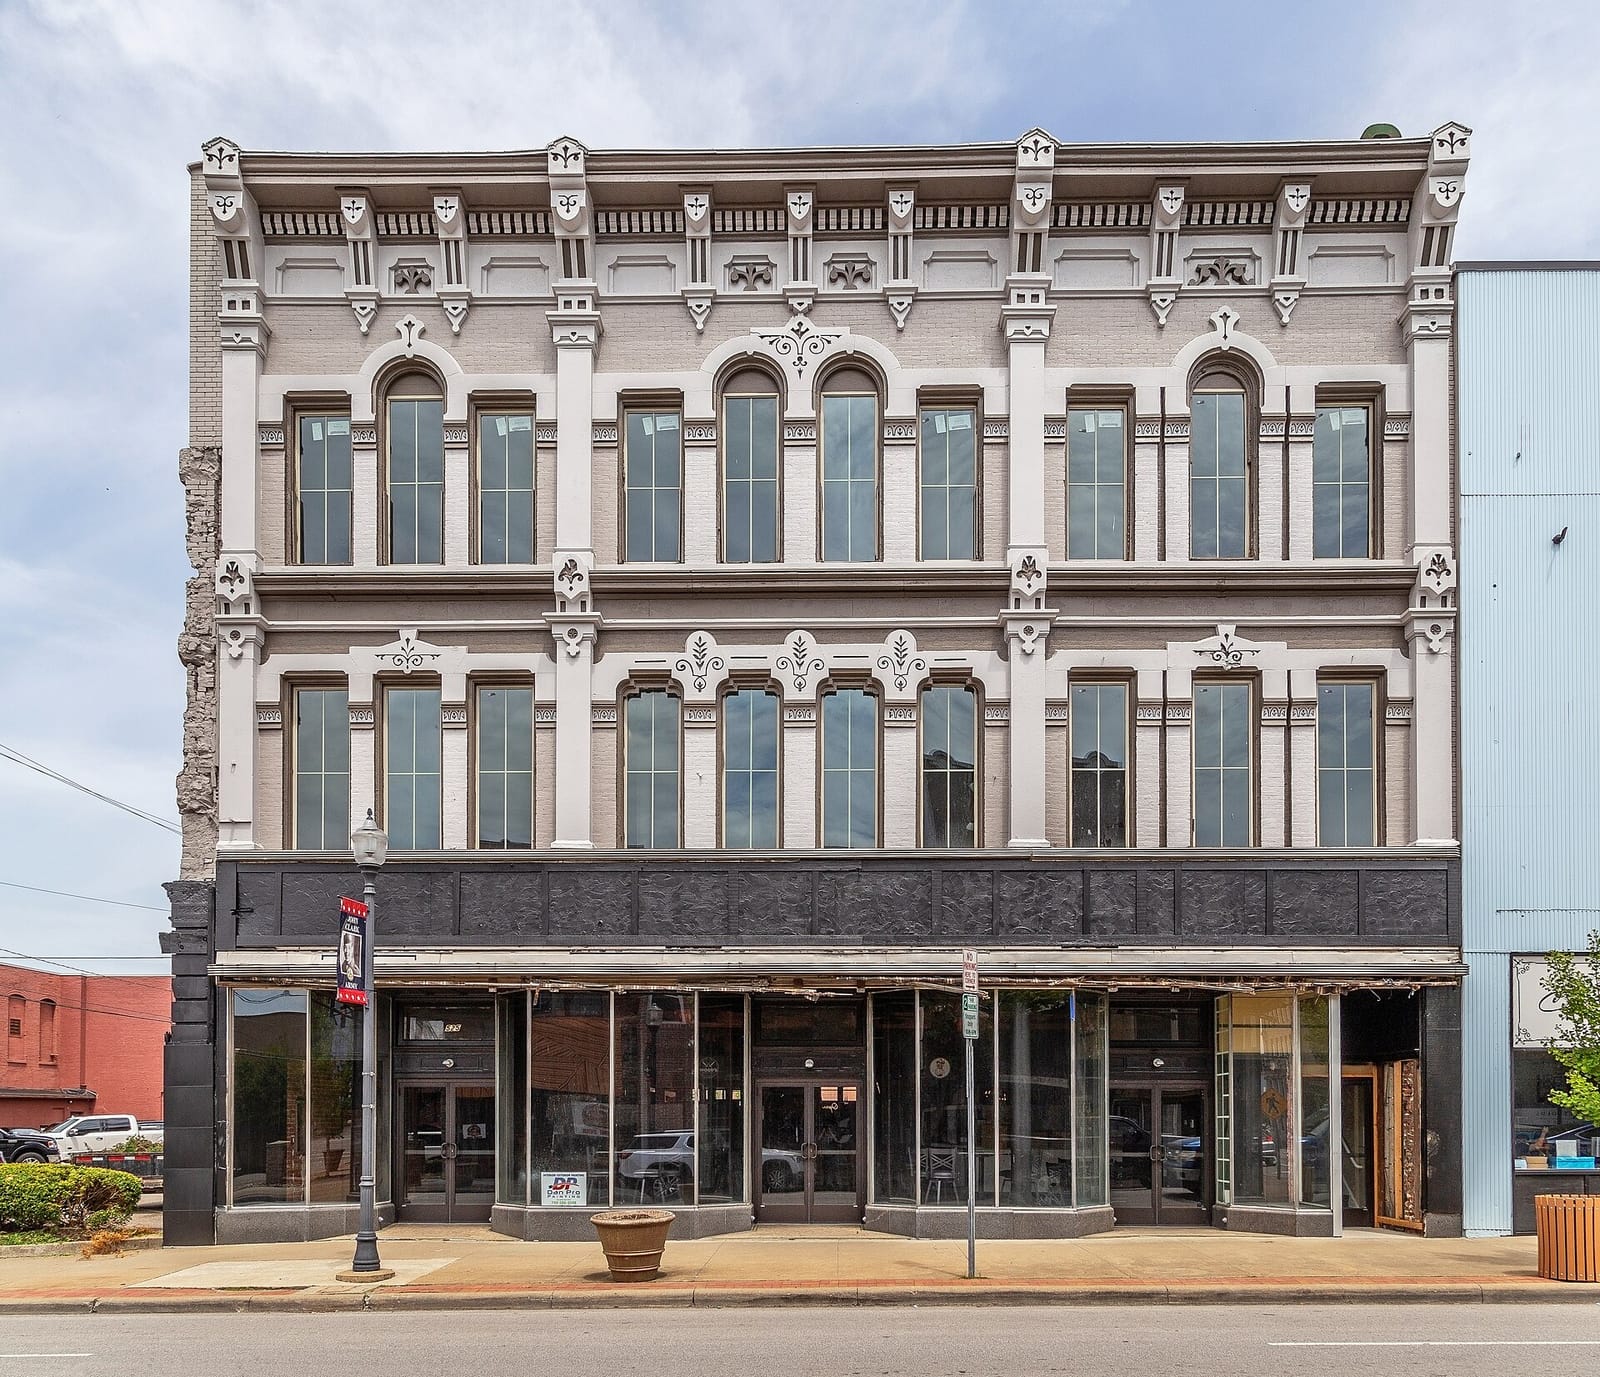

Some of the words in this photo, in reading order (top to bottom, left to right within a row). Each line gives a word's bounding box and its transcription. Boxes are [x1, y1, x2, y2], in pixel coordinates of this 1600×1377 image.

[346, 916, 359, 925] JOHN
[344, 924, 360, 934] CLARK
[966, 952, 974, 961] NO
[963, 962, 977, 971] PARKING
[345, 981, 358, 989] ARMY
